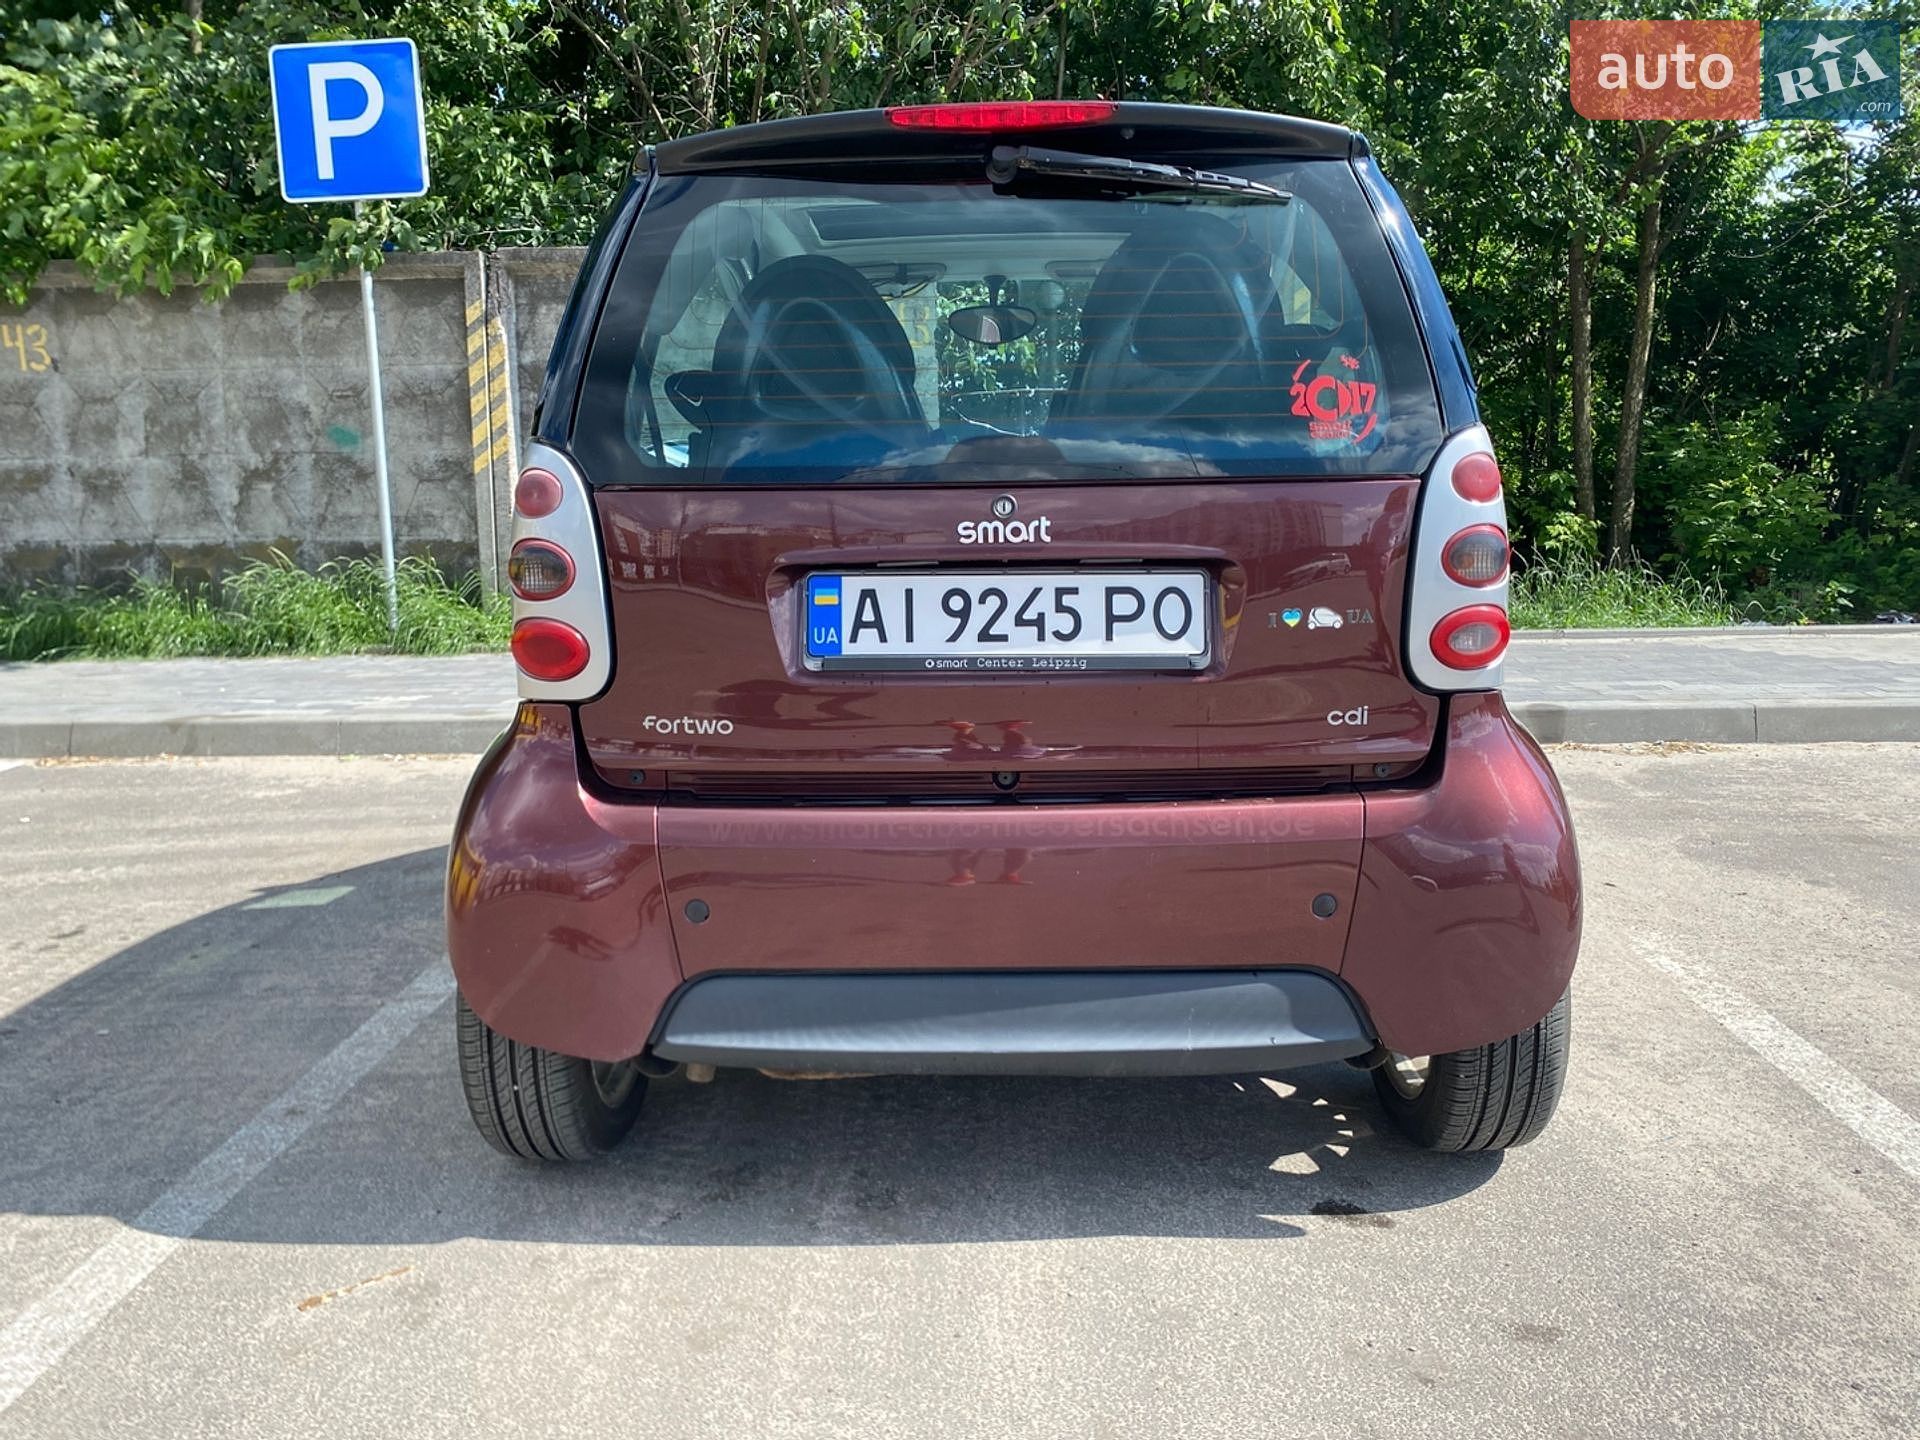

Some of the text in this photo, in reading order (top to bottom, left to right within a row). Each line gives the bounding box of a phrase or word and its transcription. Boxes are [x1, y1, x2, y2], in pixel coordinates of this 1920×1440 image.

[307, 60, 384, 180] P
[1, 323, 52, 372] 43
[957, 515, 1052, 545] smart
[848, 585, 1193, 644] AI 9245 PO
[1345, 608, 1375, 625] UA
[813, 626, 839, 645] UA
[936, 657, 1088, 670] smart Center Leipzig
[1326, 705, 1369, 726] cdi
